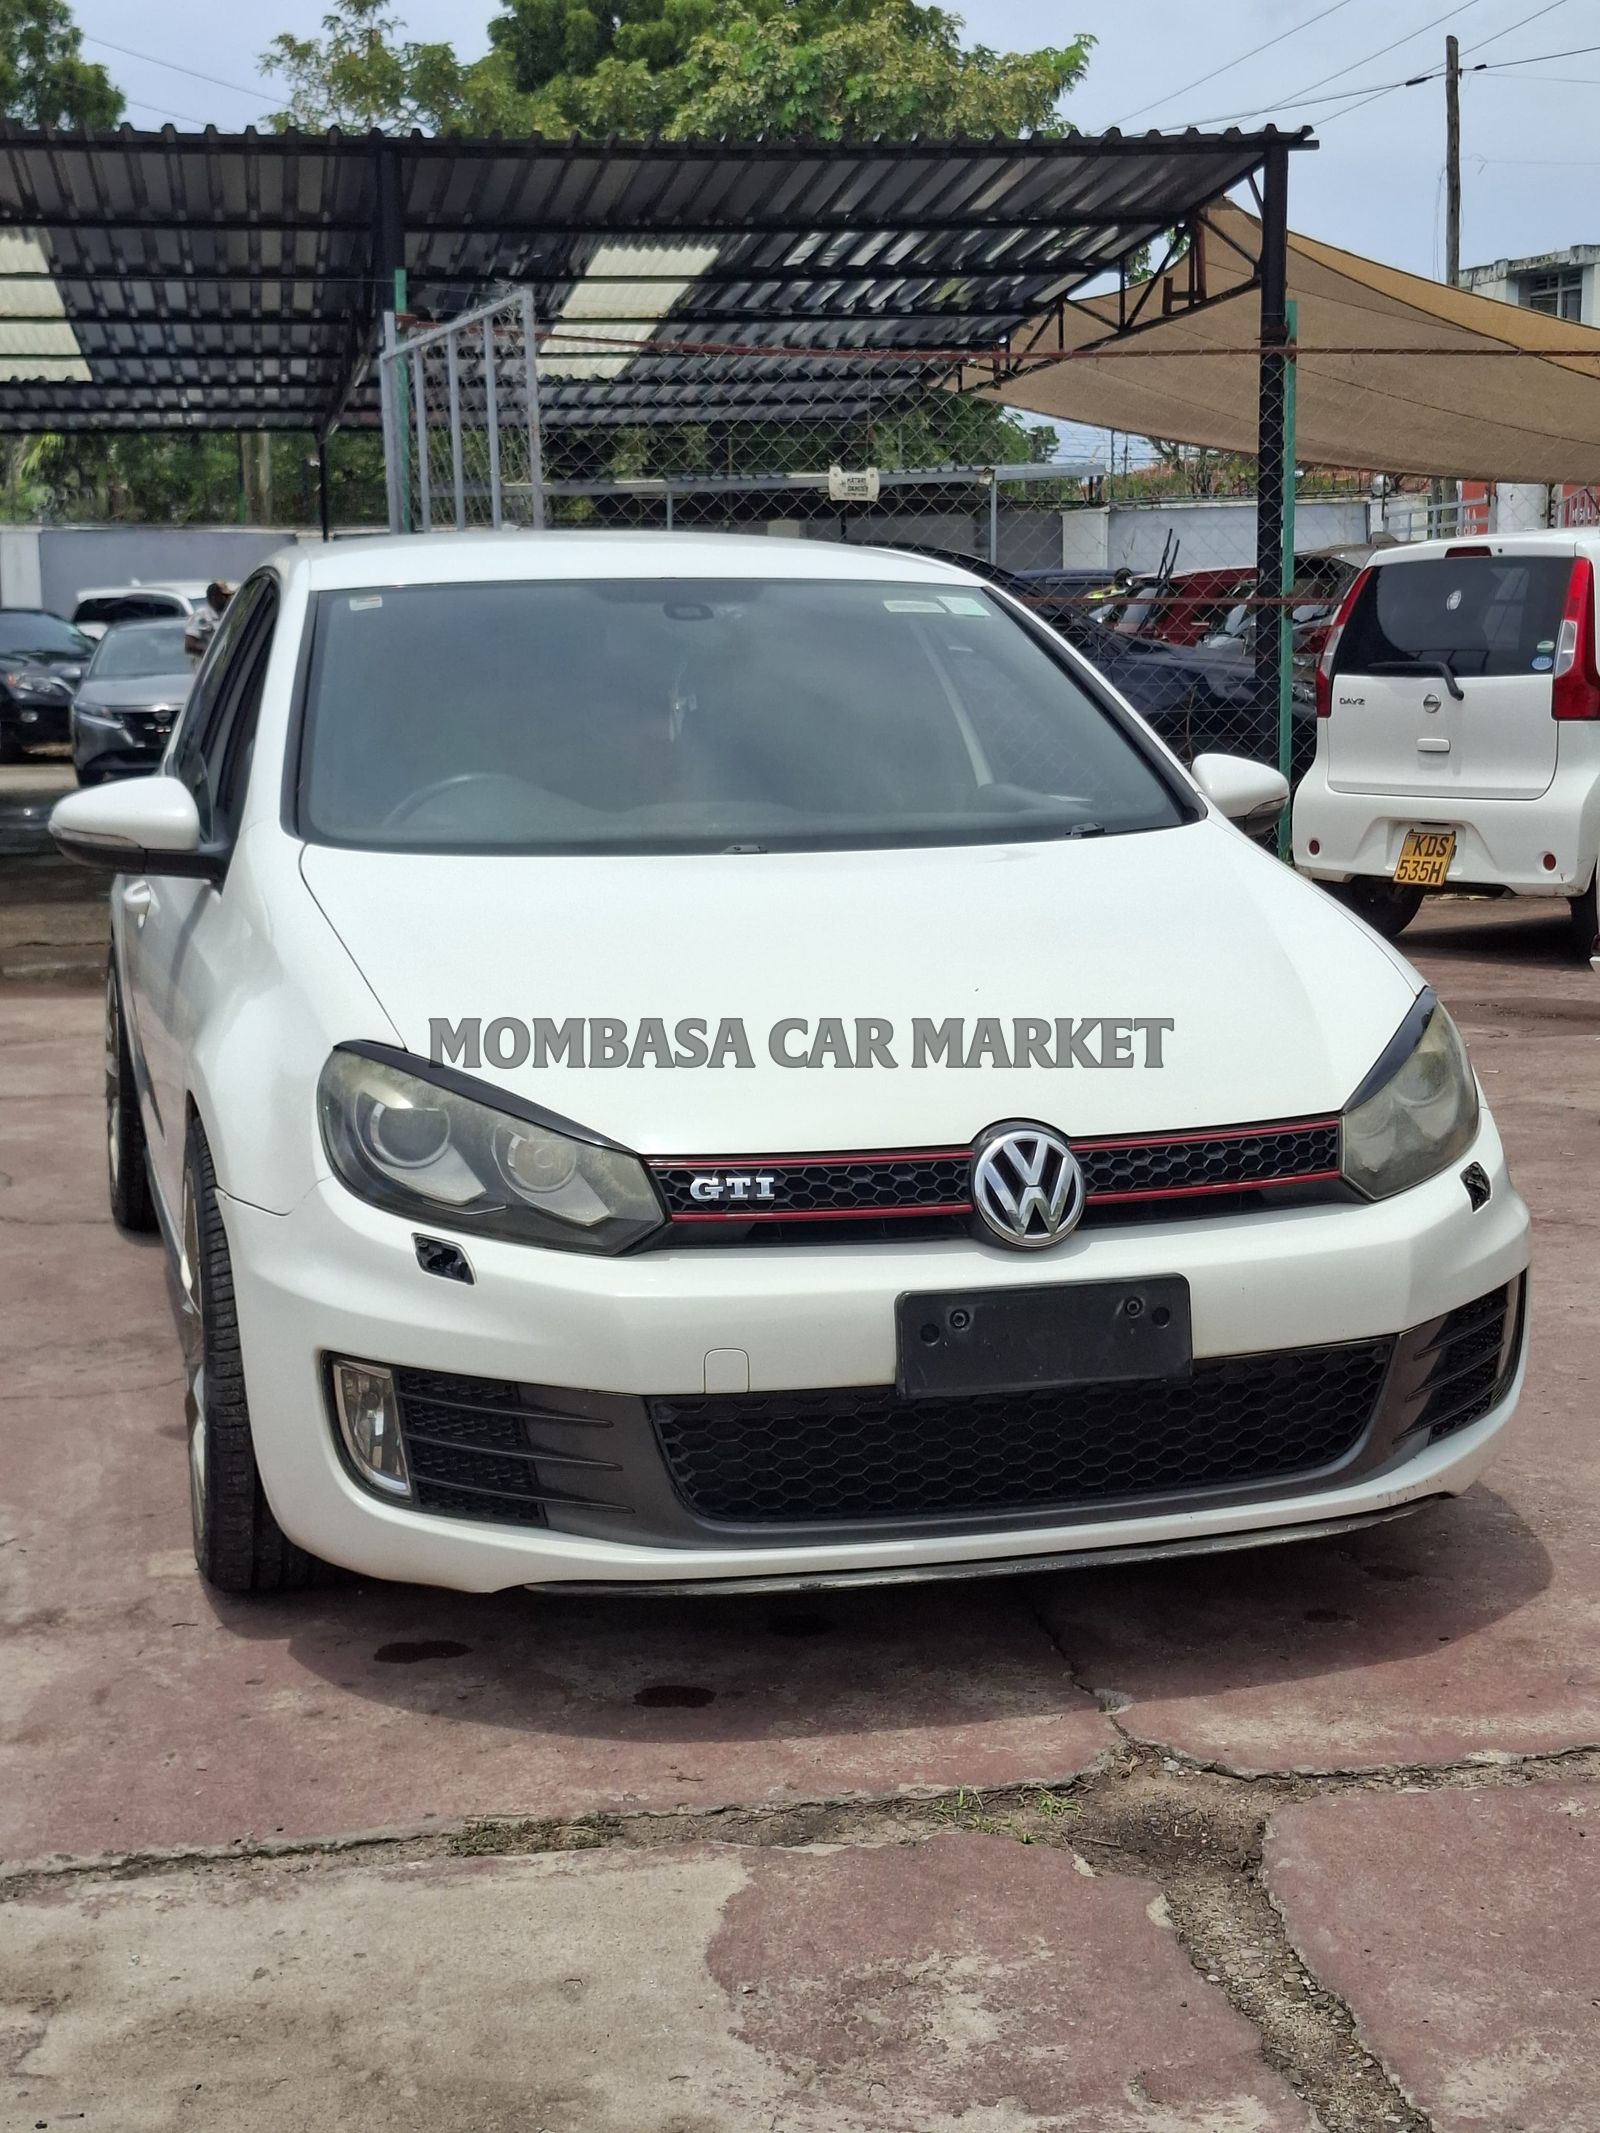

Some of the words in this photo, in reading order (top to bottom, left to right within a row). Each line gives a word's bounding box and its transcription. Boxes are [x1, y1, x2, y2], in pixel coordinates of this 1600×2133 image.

[1339, 697, 1366, 706] DAYZ
[1412, 834, 1450, 858] KDS
[1396, 859, 1444, 883] 535H
[689, 1176, 775, 1201] GTI
